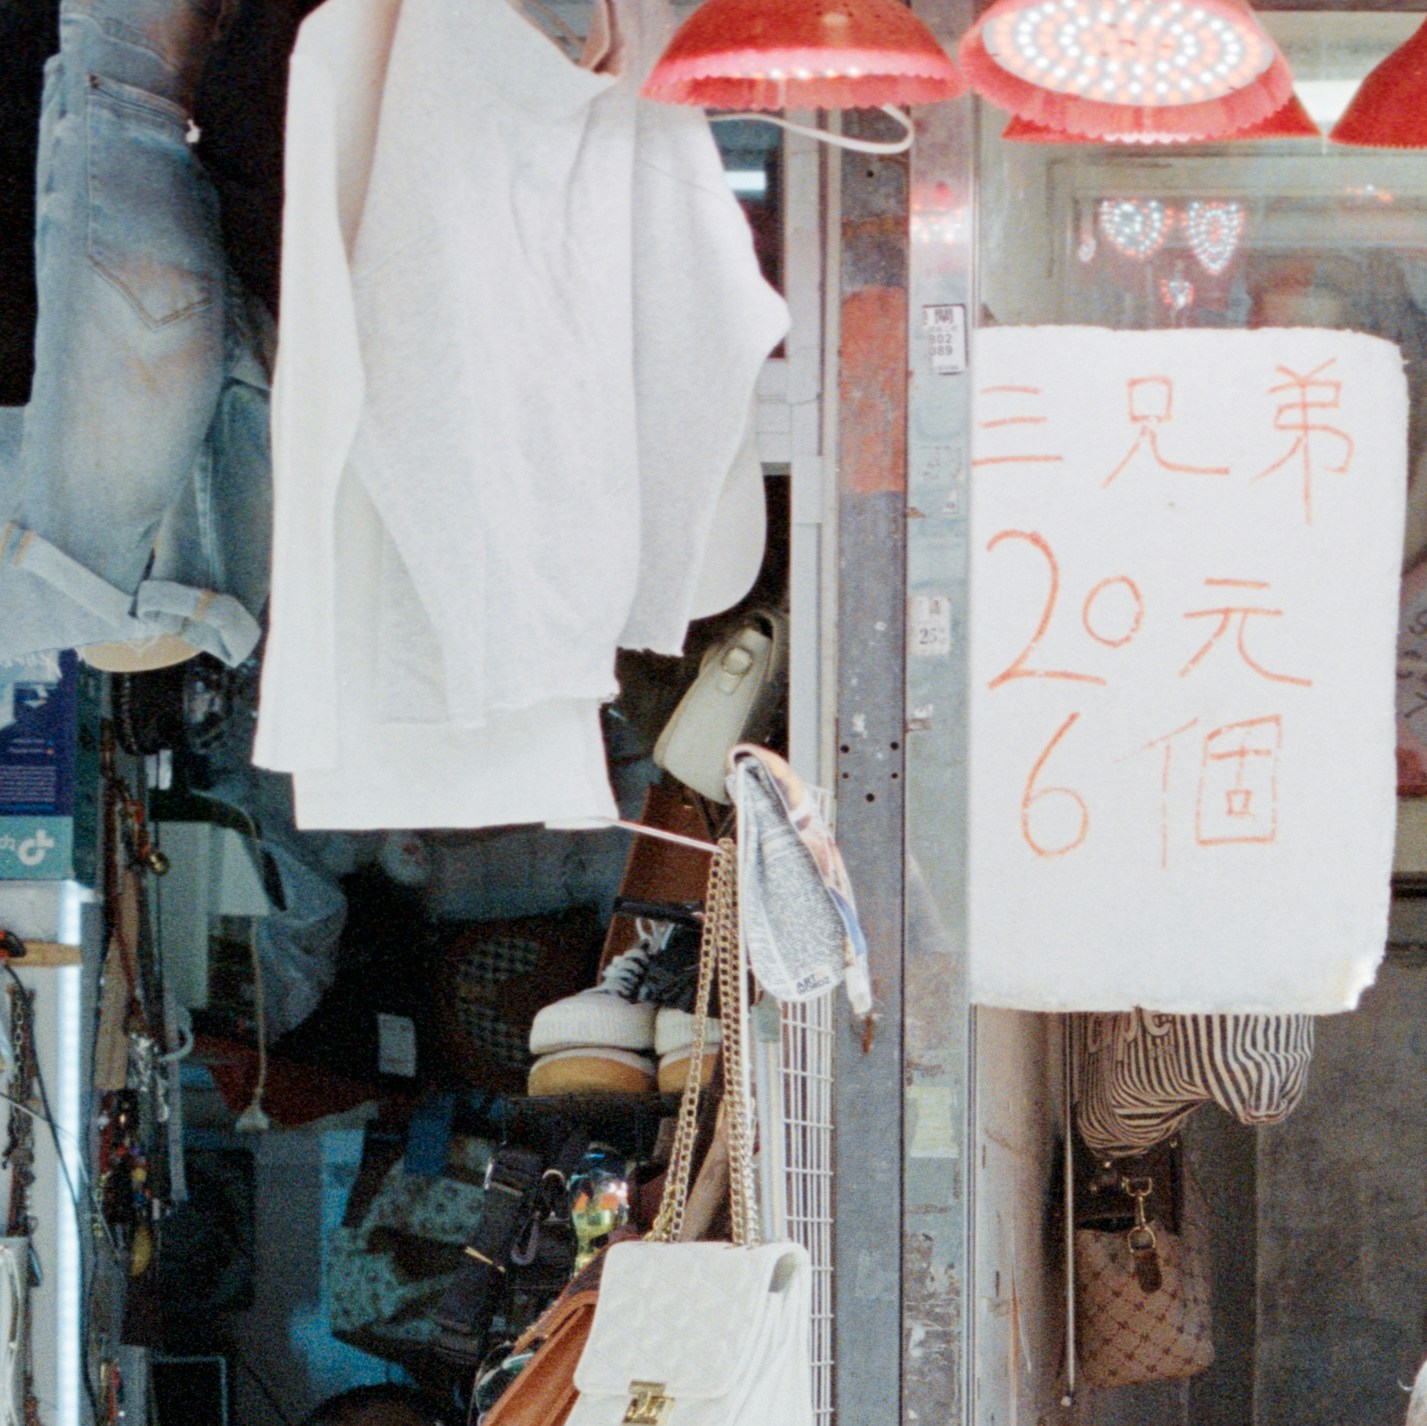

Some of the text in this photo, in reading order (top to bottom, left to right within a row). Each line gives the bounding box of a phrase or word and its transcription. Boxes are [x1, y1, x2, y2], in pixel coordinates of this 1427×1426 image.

[972, 358, 1355, 525] 三兄弟
[1021, 712, 1282, 869] 6個
